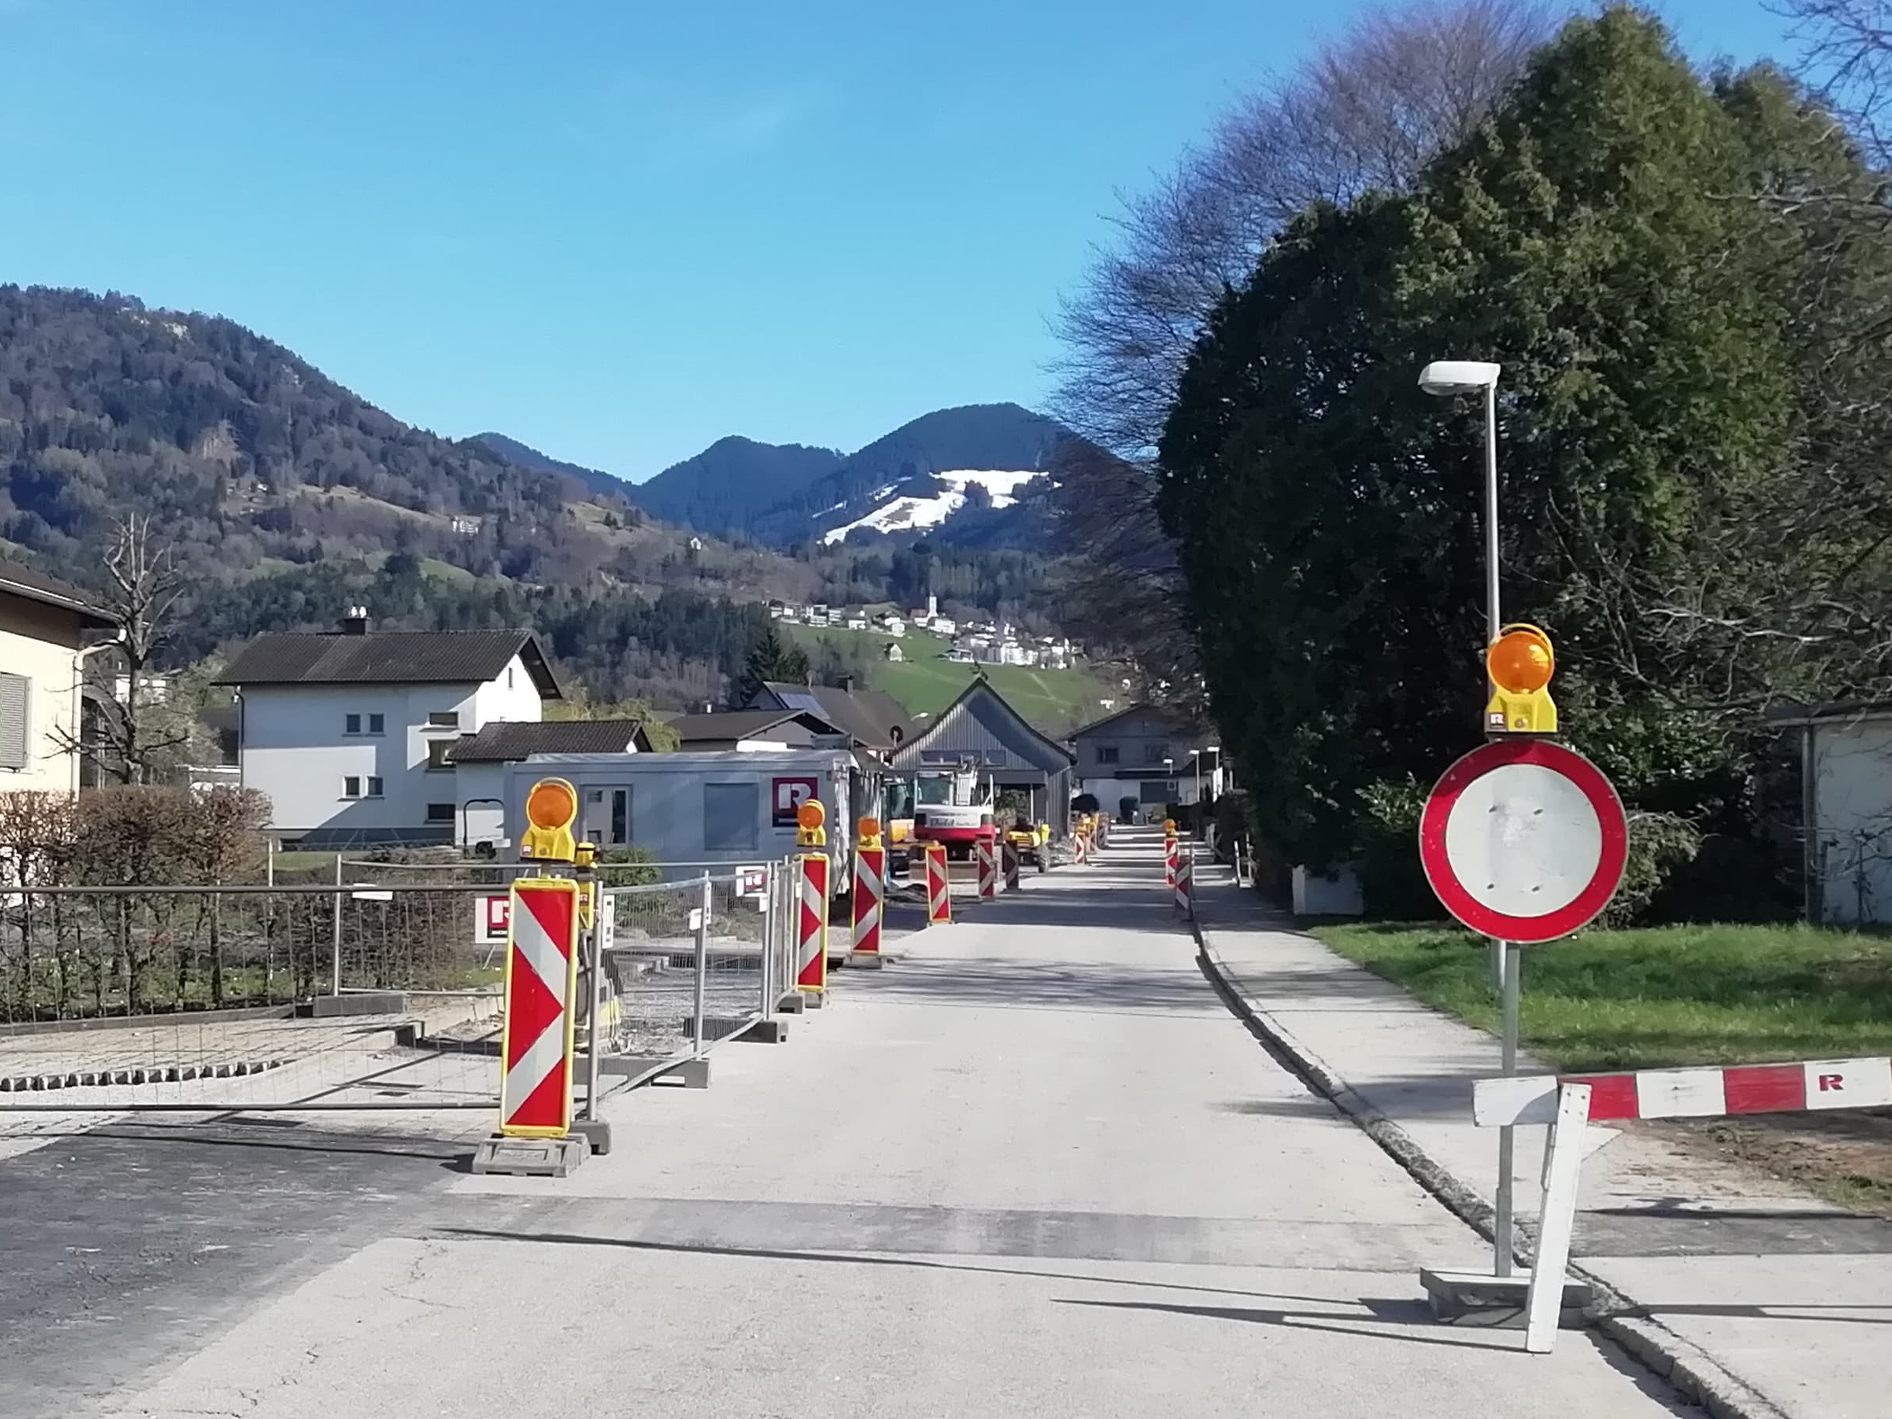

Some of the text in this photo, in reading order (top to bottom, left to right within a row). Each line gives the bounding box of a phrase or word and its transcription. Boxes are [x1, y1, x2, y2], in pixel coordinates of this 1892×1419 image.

[1490, 713, 1504, 724] R
[778, 783, 812, 809] R
[1819, 1074, 1844, 1091] R
